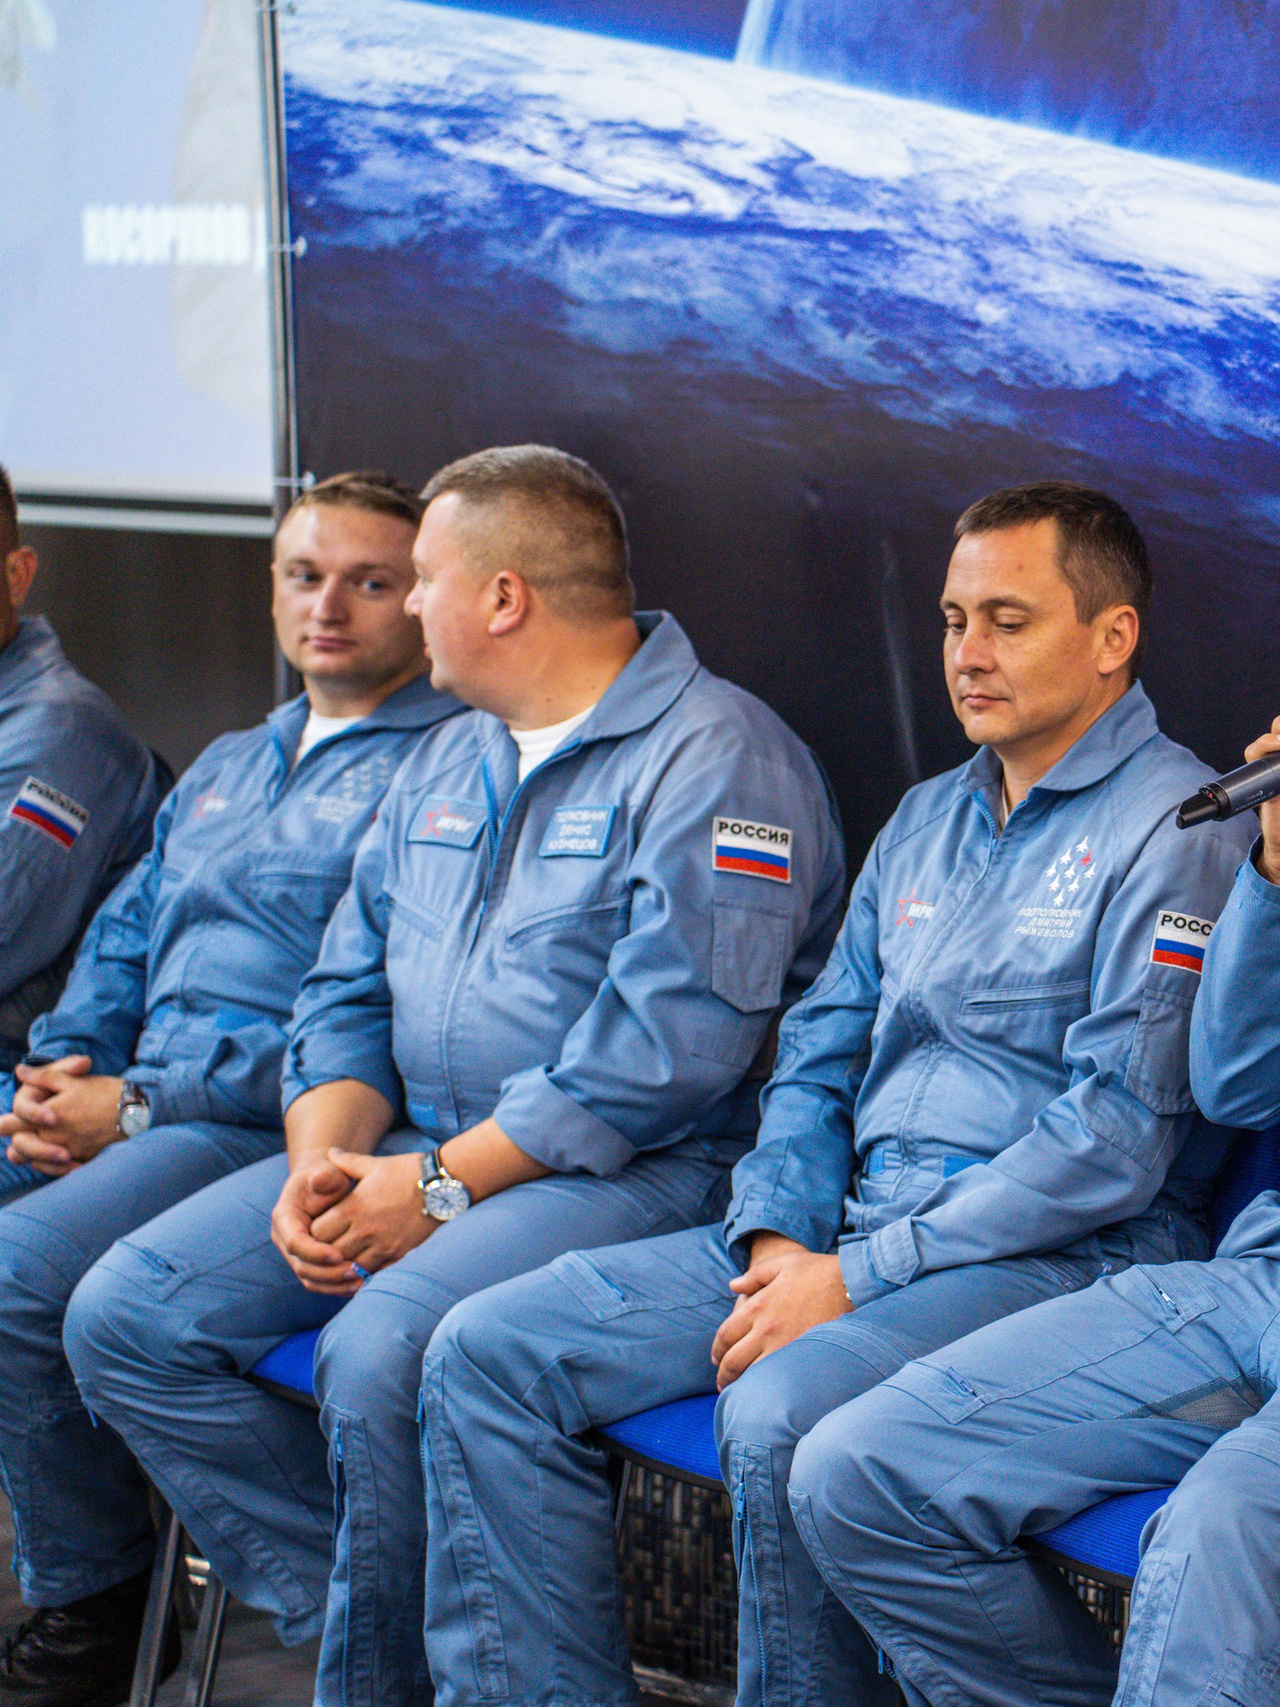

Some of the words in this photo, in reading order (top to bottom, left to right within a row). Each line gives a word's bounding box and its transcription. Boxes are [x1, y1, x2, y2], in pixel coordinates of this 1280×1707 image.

[718, 821, 789, 845] РОССИЯ
[907, 903, 934, 919] ОКРУ
[1017, 908, 1083, 919] ПОДПОЛКОВНИК
[1028, 918, 1073, 928] ДМИТРИЙ
[1161, 914, 1214, 936] РОСС
[1014, 926, 1075, 939] РЫЖЕВОЛОВ
